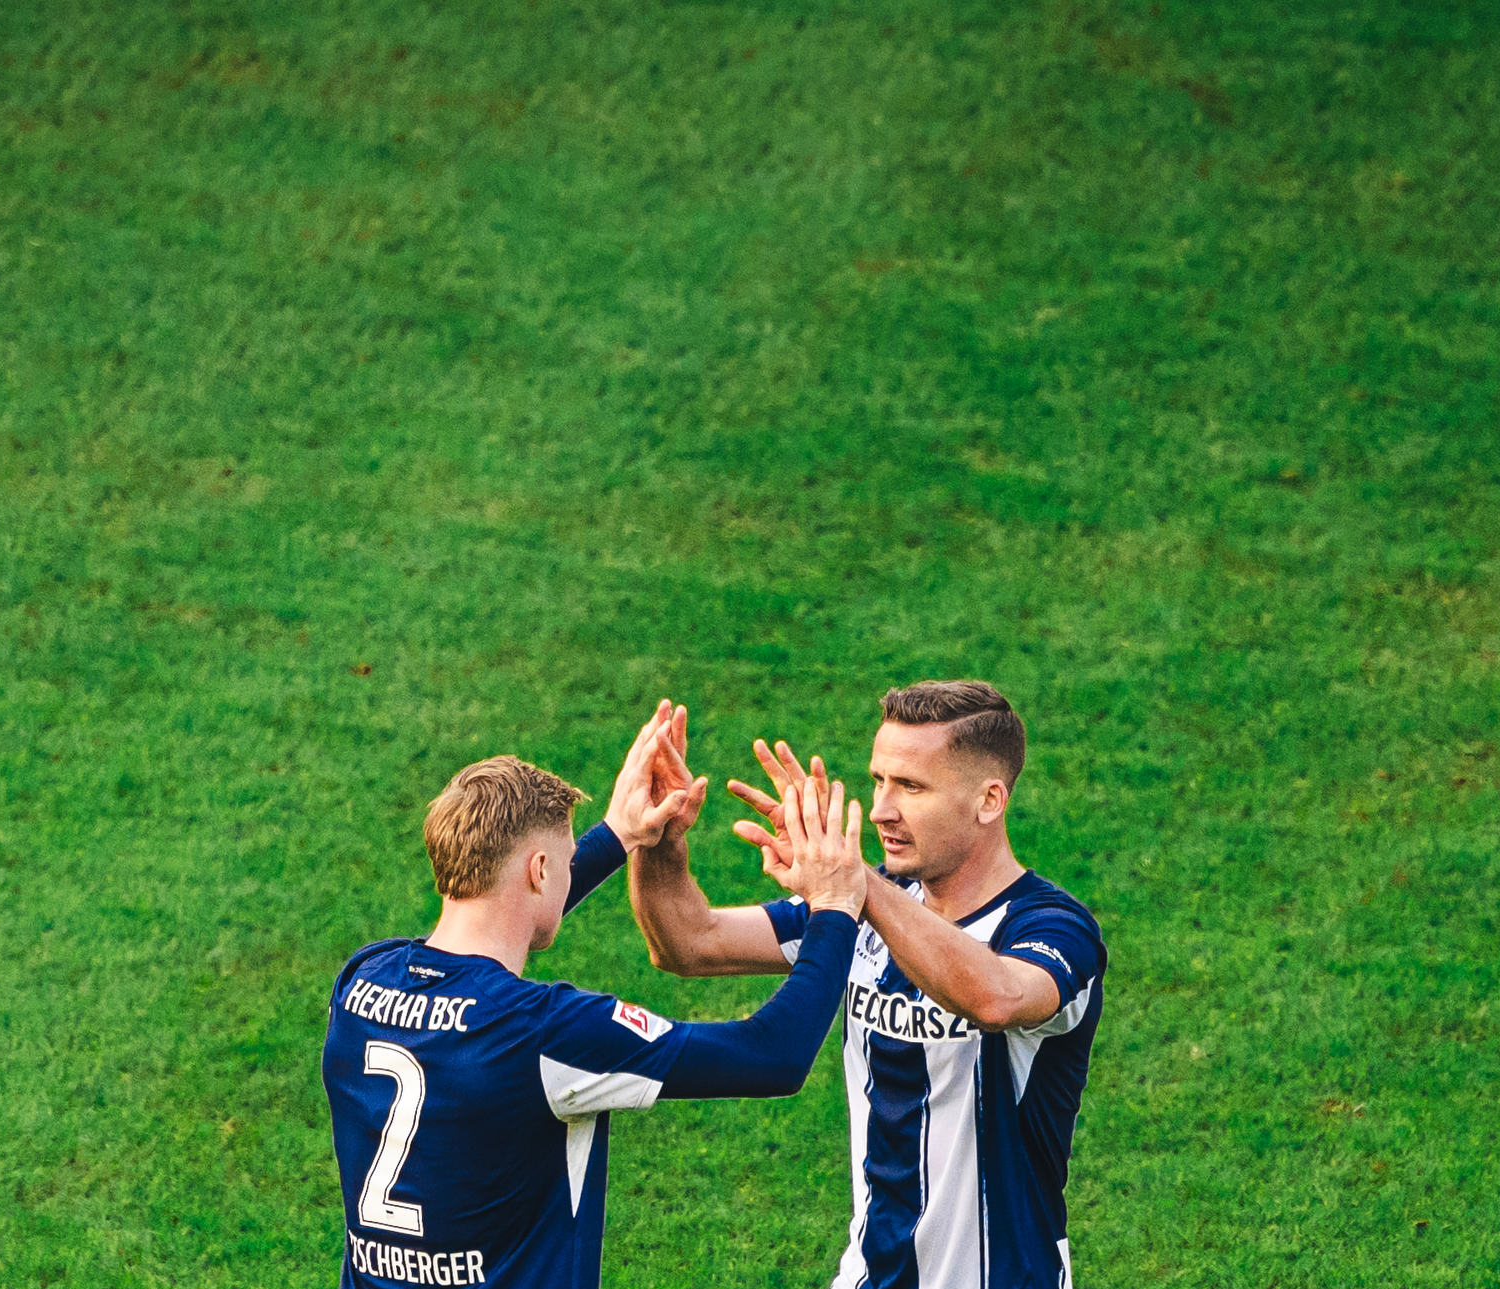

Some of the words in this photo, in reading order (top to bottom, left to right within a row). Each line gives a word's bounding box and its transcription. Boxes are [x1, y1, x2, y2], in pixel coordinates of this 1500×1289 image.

[344, 978, 429, 1030] HERTHA
[427, 995, 478, 1032] BSC
[357, 1039, 425, 1238] 2
